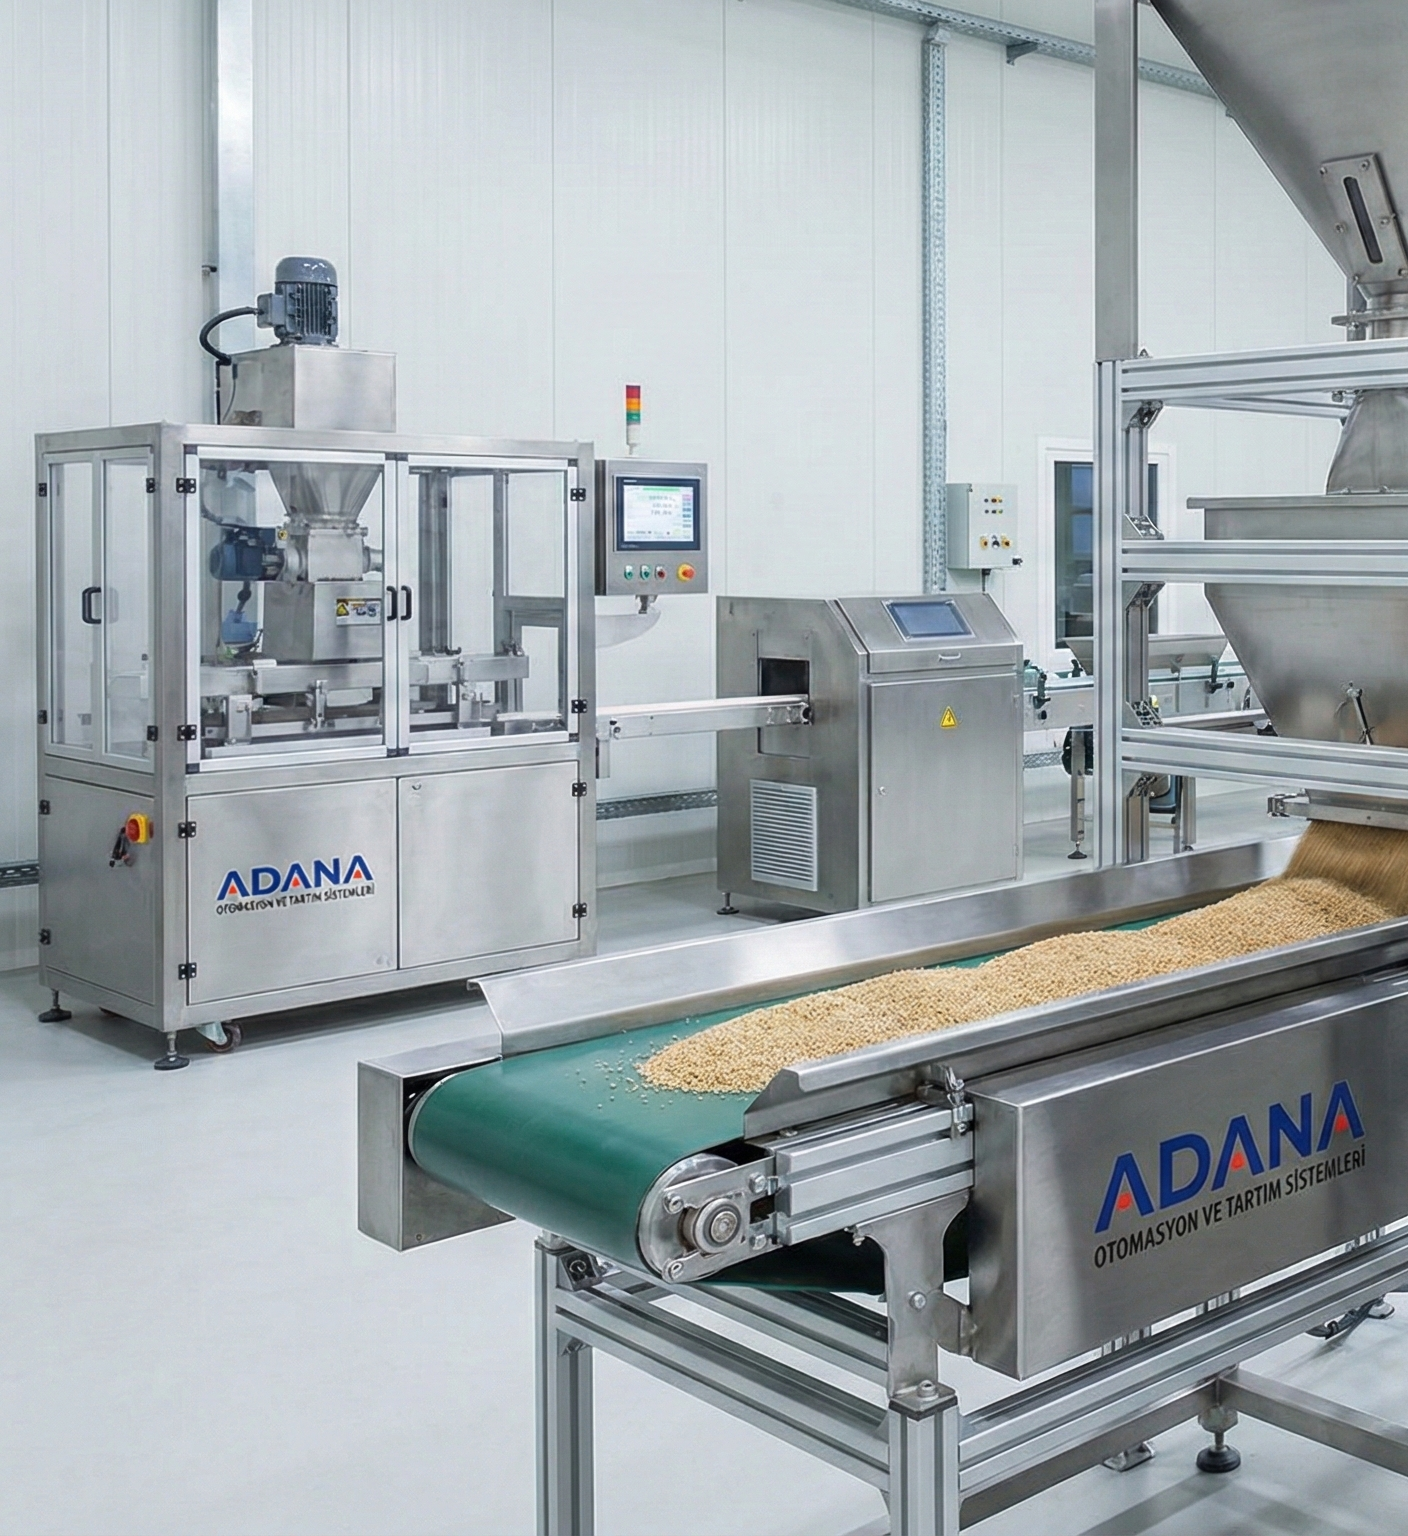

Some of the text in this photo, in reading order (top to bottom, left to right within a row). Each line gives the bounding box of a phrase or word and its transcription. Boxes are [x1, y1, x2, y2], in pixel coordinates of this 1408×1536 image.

[216, 855, 374, 901] ADANA
[1094, 1080, 1365, 1234] ADANA
[1094, 1144, 1366, 1268] OTOMASYON VE TARTIM SİSTEMLERİ
